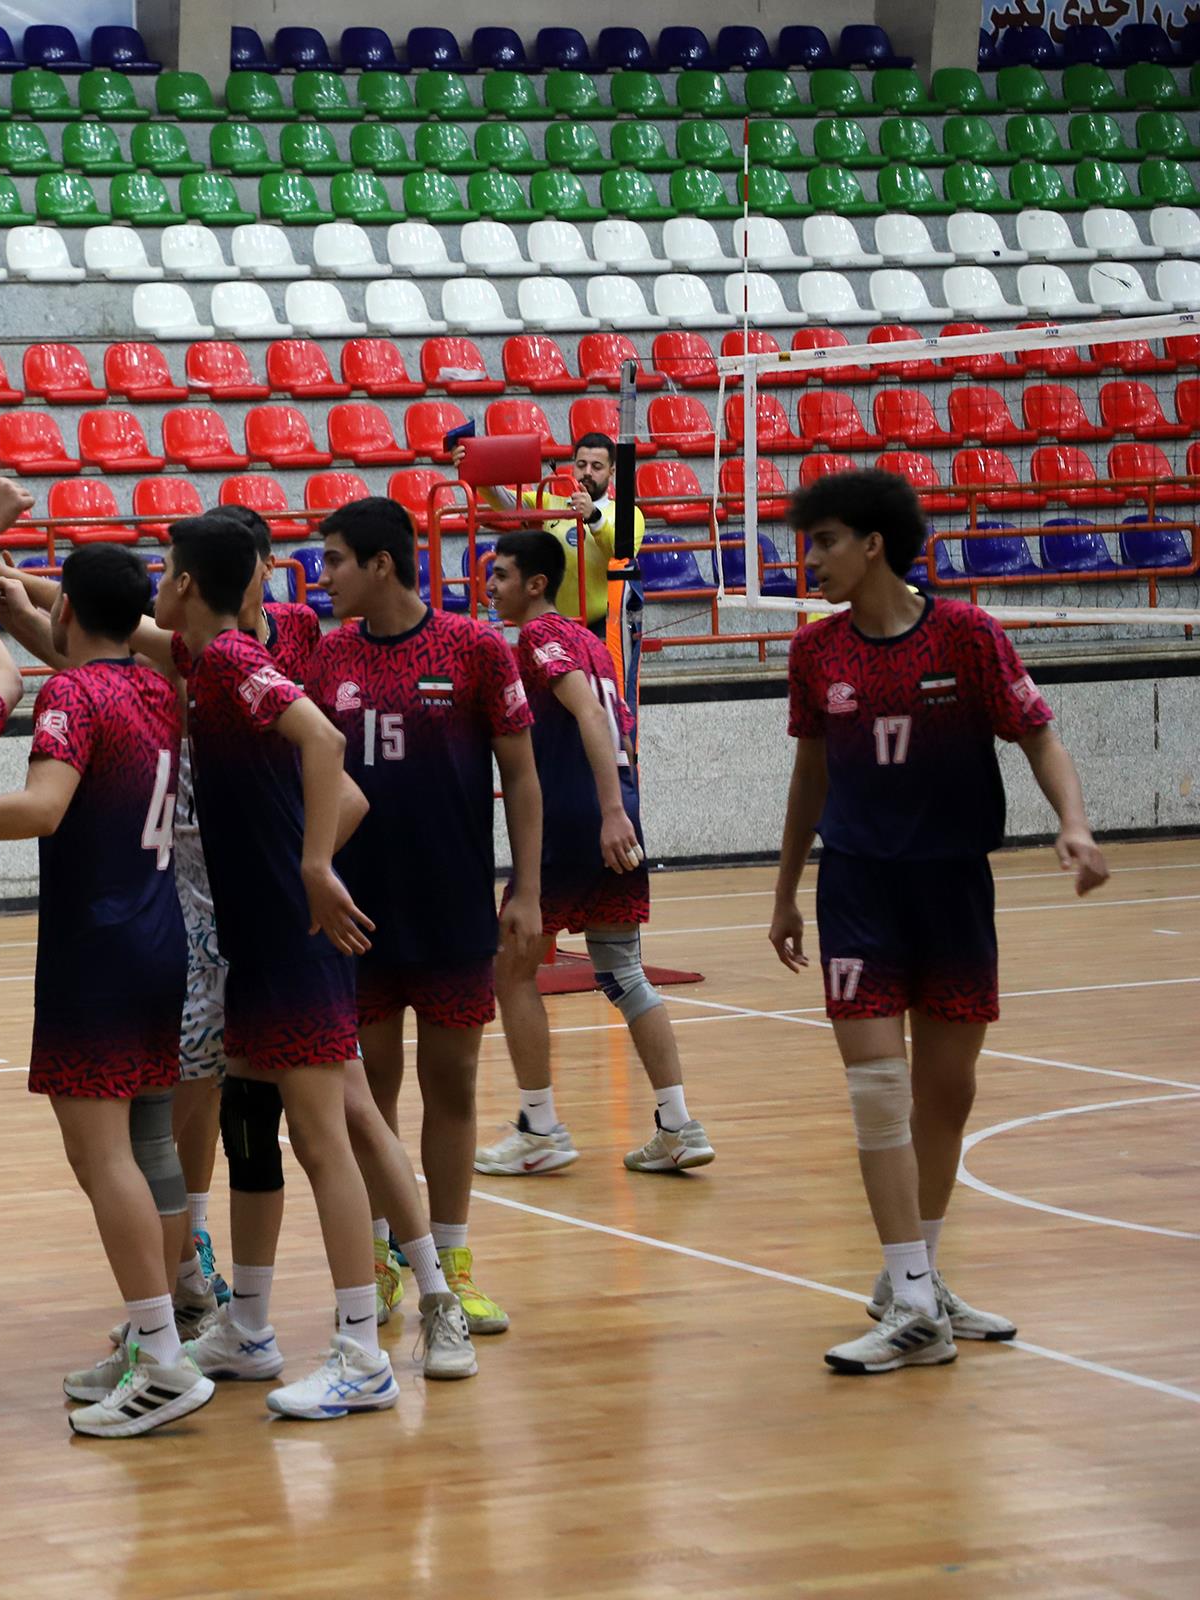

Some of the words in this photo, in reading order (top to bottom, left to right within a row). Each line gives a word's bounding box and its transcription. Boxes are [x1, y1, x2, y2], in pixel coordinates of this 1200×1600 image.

[364, 709, 405, 766] 15
[873, 715, 912, 765] 17
[830, 957, 864, 1001] 17
